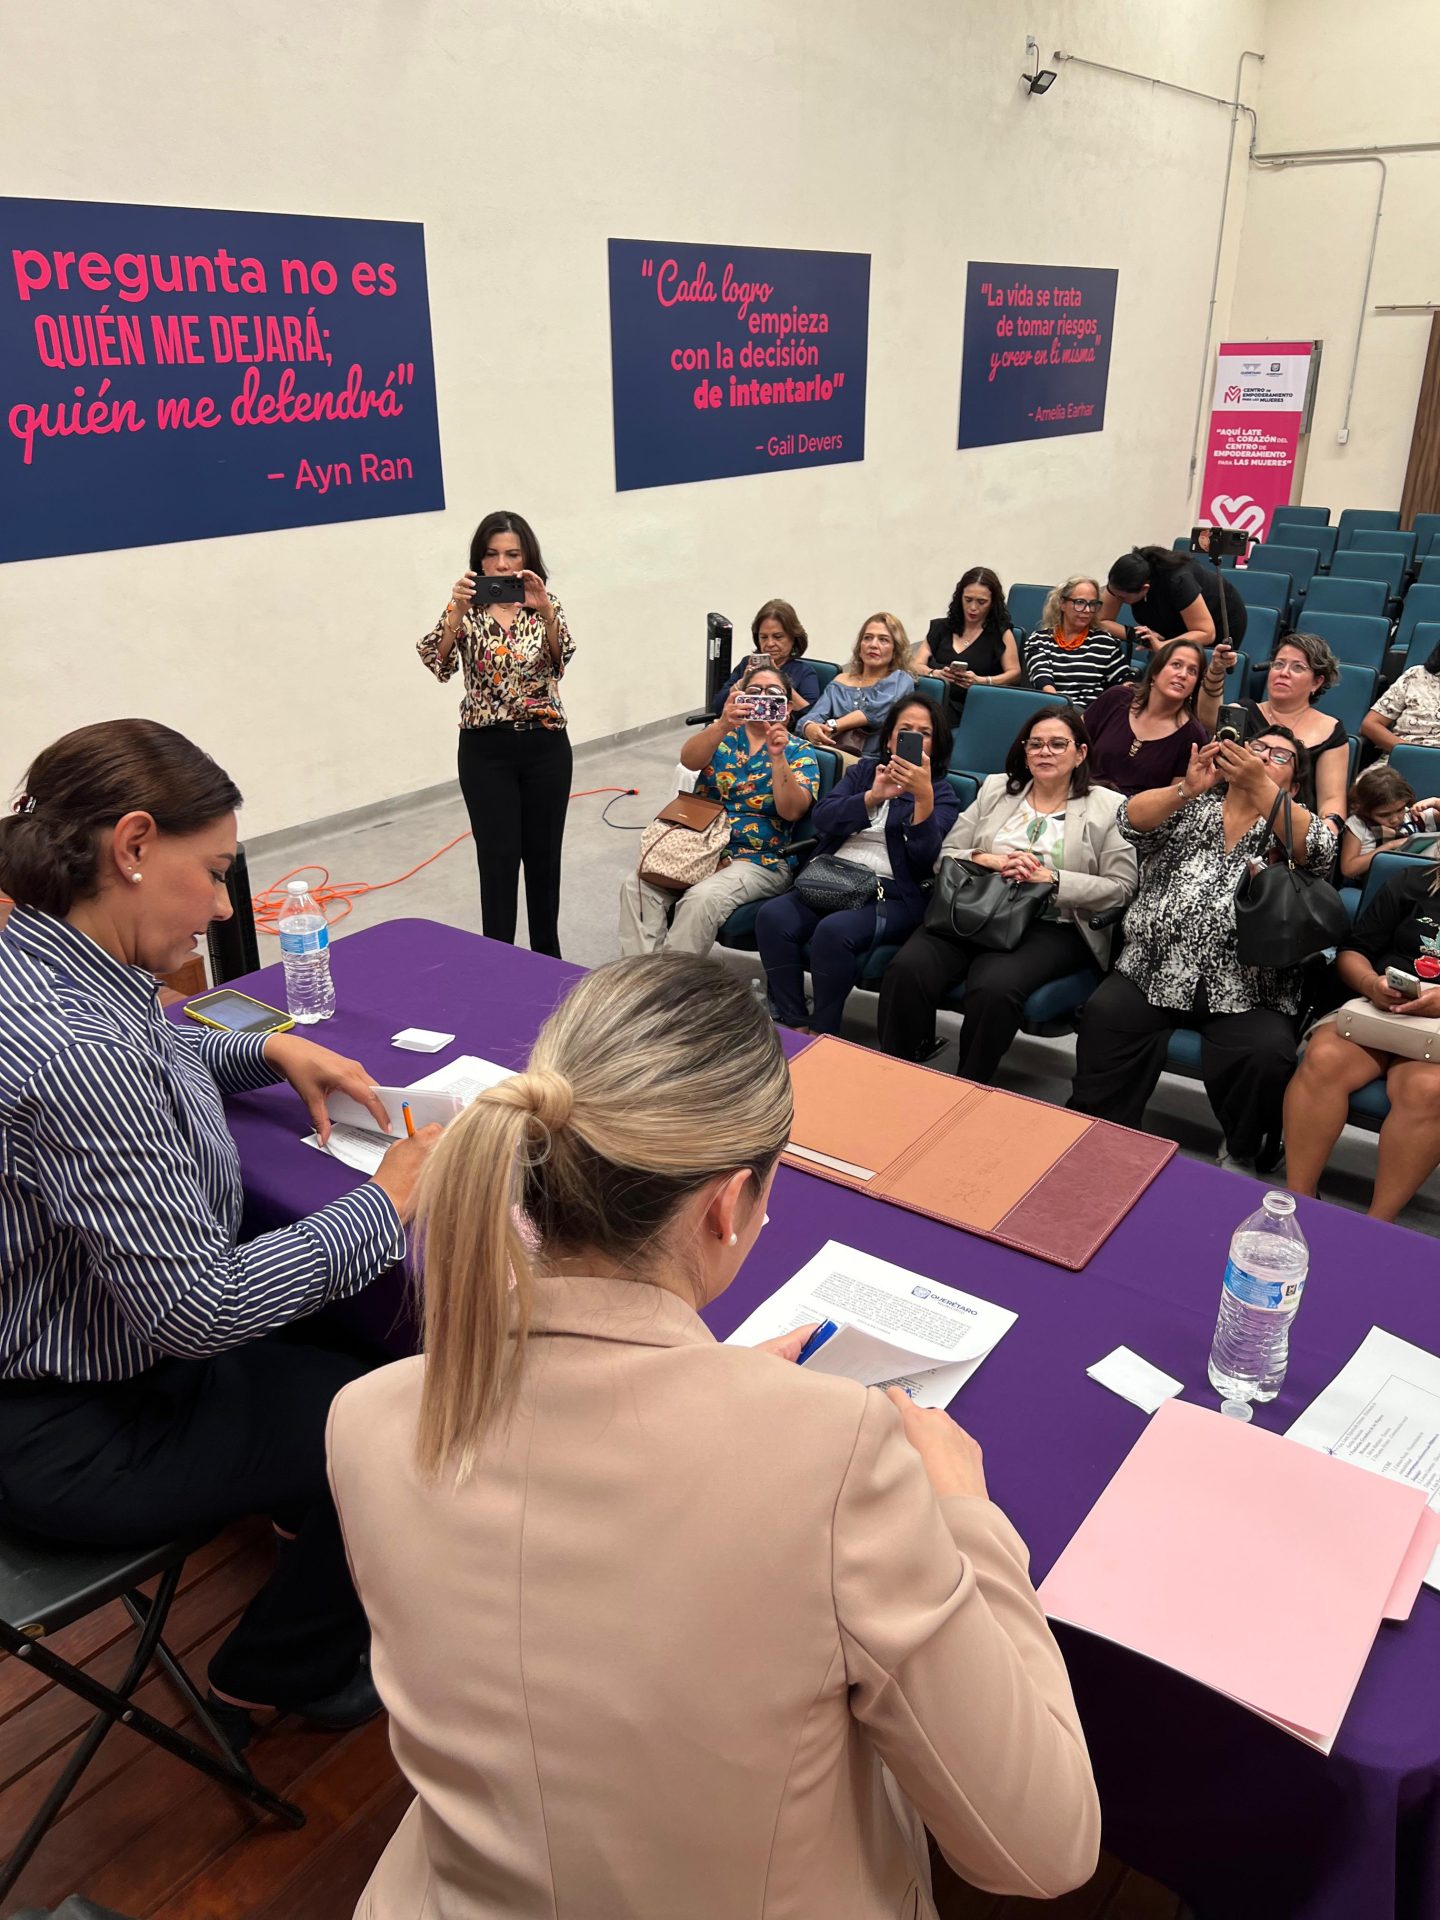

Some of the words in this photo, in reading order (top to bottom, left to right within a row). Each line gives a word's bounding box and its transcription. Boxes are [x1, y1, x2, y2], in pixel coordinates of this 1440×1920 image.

[12, 249, 266, 302] pregunta
[281, 259, 337, 295] no
[352, 262, 398, 296] es
[641, 259, 717, 307] "Cada
[722, 262, 774, 320] logro
[1007, 282, 1033, 306] vida
[1037, 292, 1050, 306] se
[1053, 287, 1082, 306] trata
[35, 305, 145, 369] QUIÉN
[151, 315, 205, 365] ME
[209, 307, 333, 367] DEJARÁ;
[748, 305, 829, 338] empieza
[996, 315, 1013, 337] de
[1017, 317, 1054, 336] tomar
[1057, 313, 1098, 339] riesgos
[671, 348, 710, 370] con
[716, 341, 733, 369] la
[740, 339, 818, 368] decisión
[988, 351, 1001, 381] y
[1002, 350, 1033, 367] creer
[1034, 351, 1049, 366] en
[1050, 337, 1060, 365] ti
[1062, 335, 1102, 364] misma"
[694, 379, 723, 409] de
[729, 373, 845, 407] intentarlo"
[8, 378, 146, 464] quién
[157, 397, 221, 429] me
[231, 363, 415, 427] detendrá"
[1035, 404, 1065, 422] Amelia
[1067, 402, 1094, 419] Earhar
[768, 436, 794, 456] Gail
[798, 434, 842, 453] Devers
[1213, 450, 1287, 458] EMPODERAMIENTO
[295, 459, 351, 493] Ayn
[361, 454, 413, 483] Ran
[929, 1293, 978, 1316] QUERÉTARO
